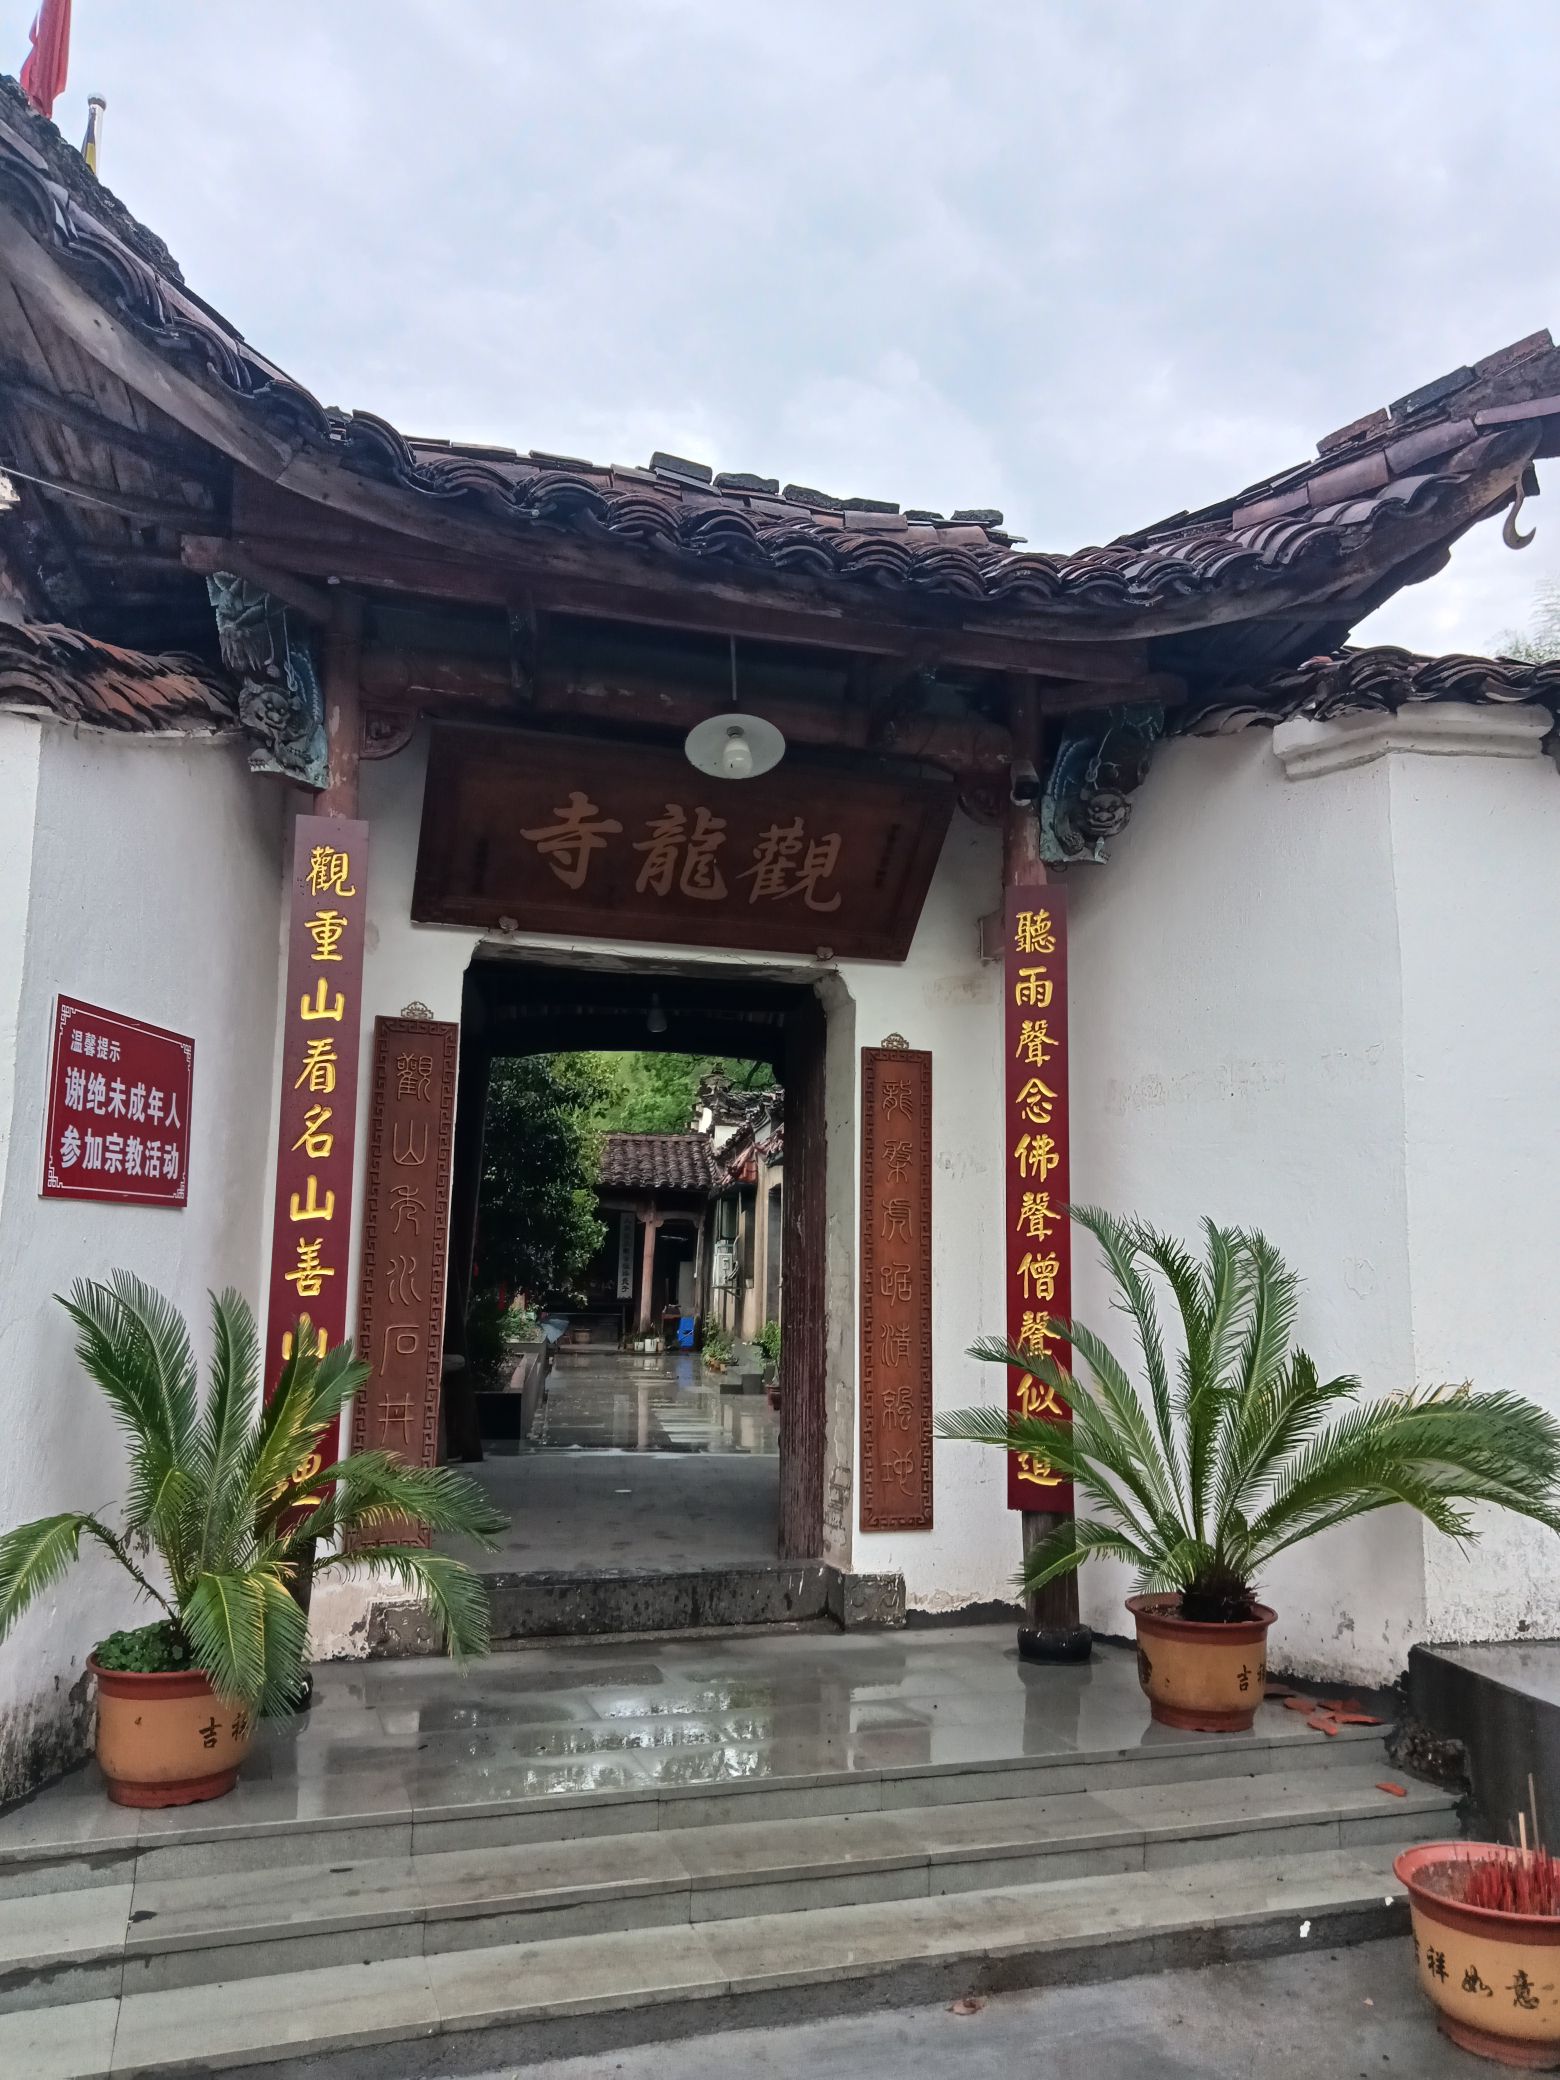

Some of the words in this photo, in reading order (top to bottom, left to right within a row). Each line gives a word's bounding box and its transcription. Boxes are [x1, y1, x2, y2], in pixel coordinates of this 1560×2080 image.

[70, 1028, 121, 1063] 温馨提示
[64, 1066, 181, 1129] 谢绝未成年人
[60, 1124, 179, 1180] 参加宗教活动
